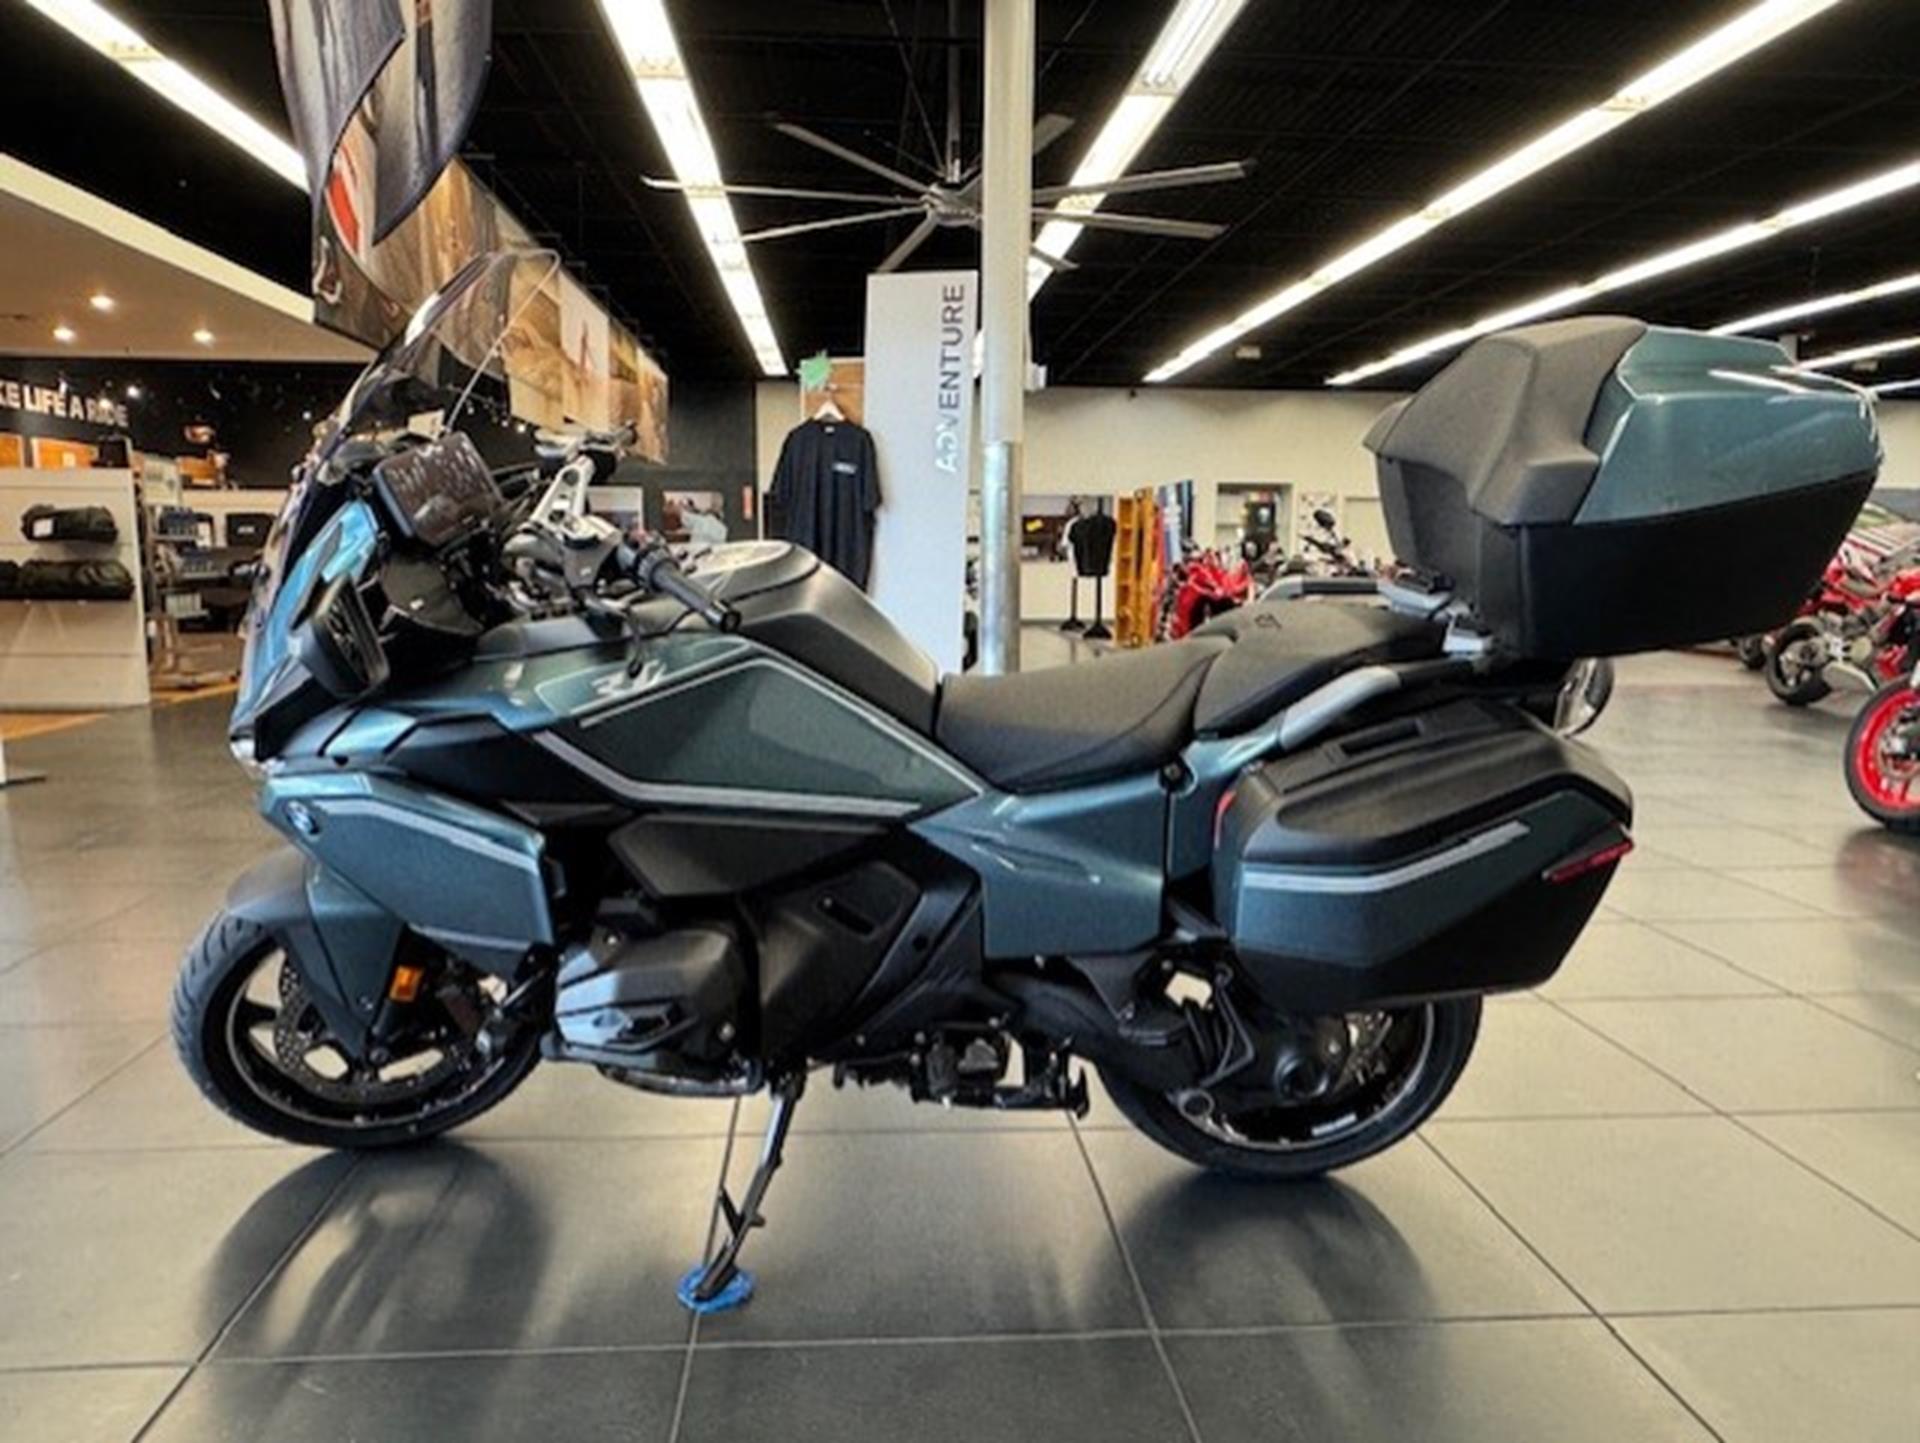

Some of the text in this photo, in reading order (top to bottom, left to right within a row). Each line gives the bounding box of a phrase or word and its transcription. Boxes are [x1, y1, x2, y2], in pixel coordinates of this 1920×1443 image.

[22, 384, 67, 418] LIFE
[69, 394, 85, 421] A
[935, 284, 965, 473] ADVENTURE
